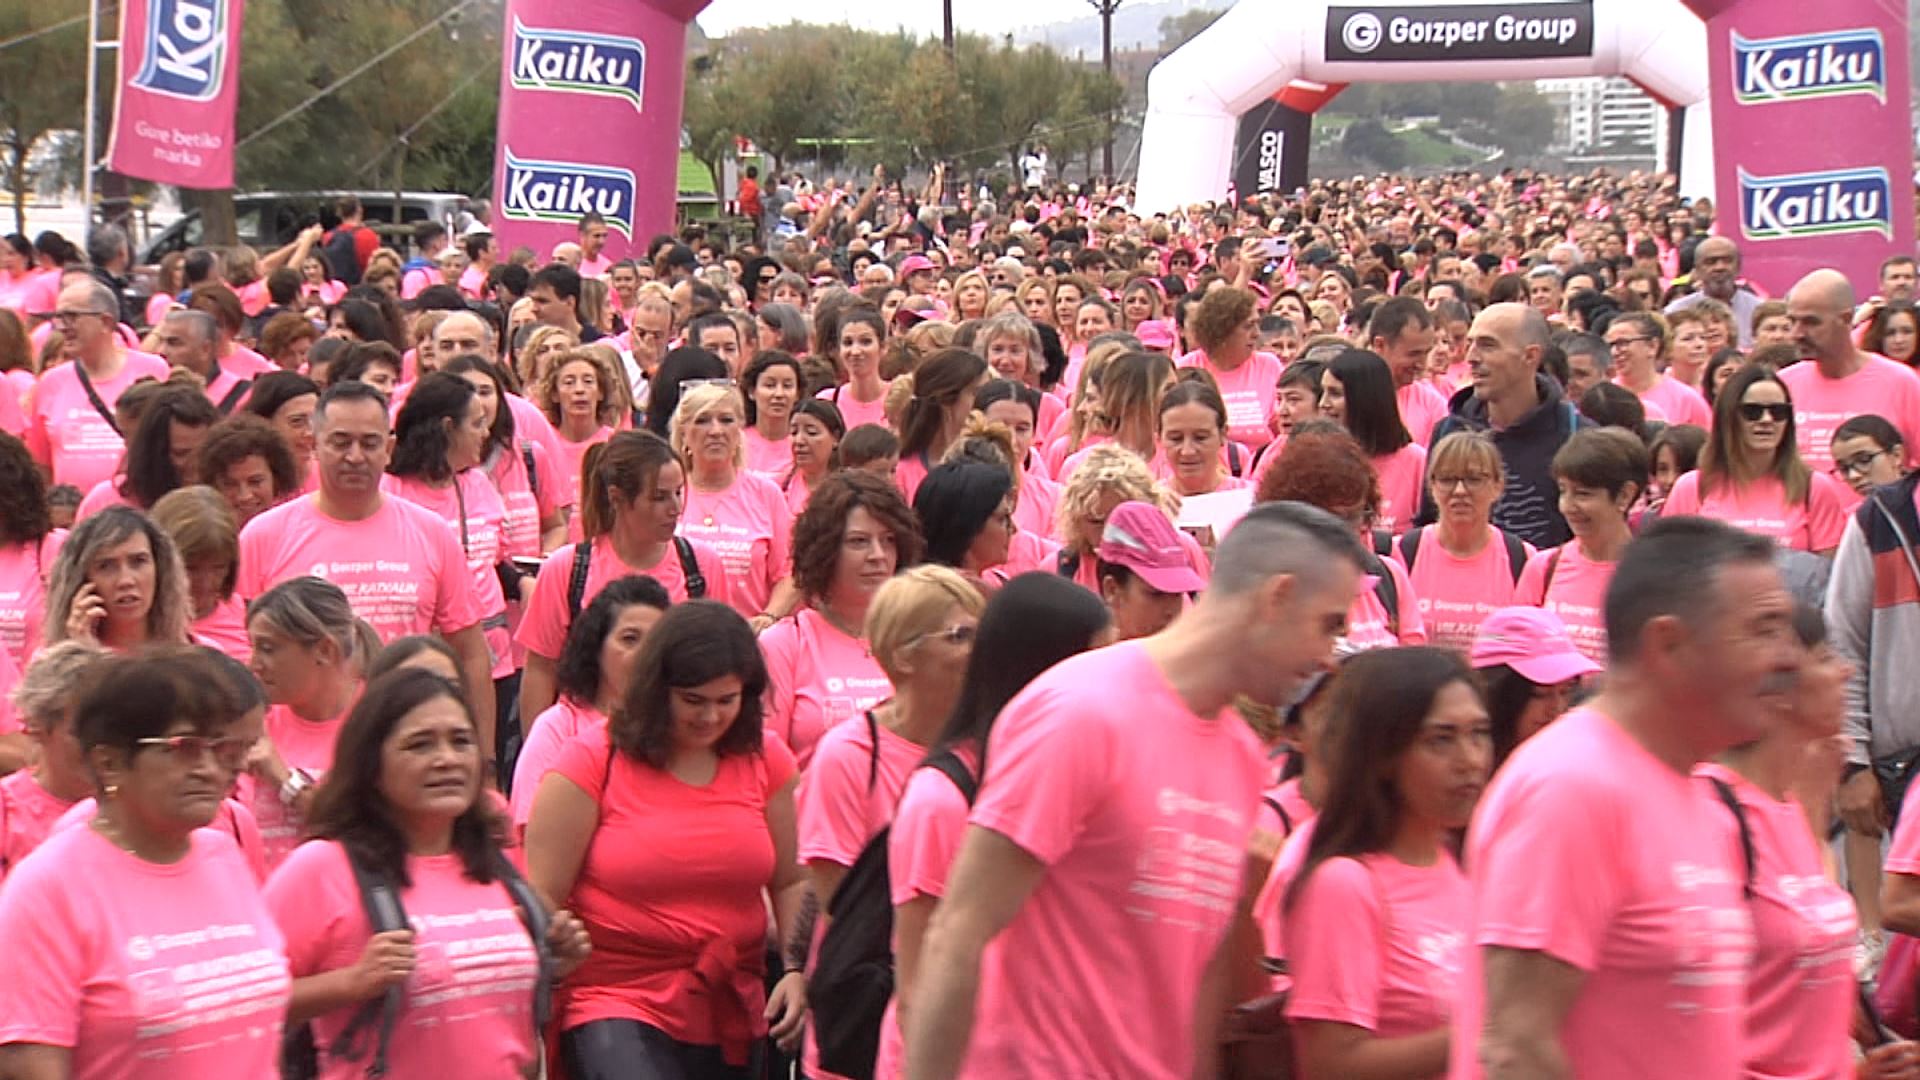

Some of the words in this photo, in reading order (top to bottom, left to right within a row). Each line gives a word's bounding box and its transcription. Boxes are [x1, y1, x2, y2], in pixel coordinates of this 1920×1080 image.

[1389, 17, 1488, 47] Goizper
[1495, 15, 1577, 44] Group
[518, 39, 631, 86] Kaiku
[1744, 45, 1872, 97] Kaiku
[153, 147, 202, 167] marka
[172, 128, 222, 149] betiko
[1258, 131, 1277, 191] VASCO
[509, 170, 620, 217] Kaiku
[1752, 183, 1879, 234] Kaiku
